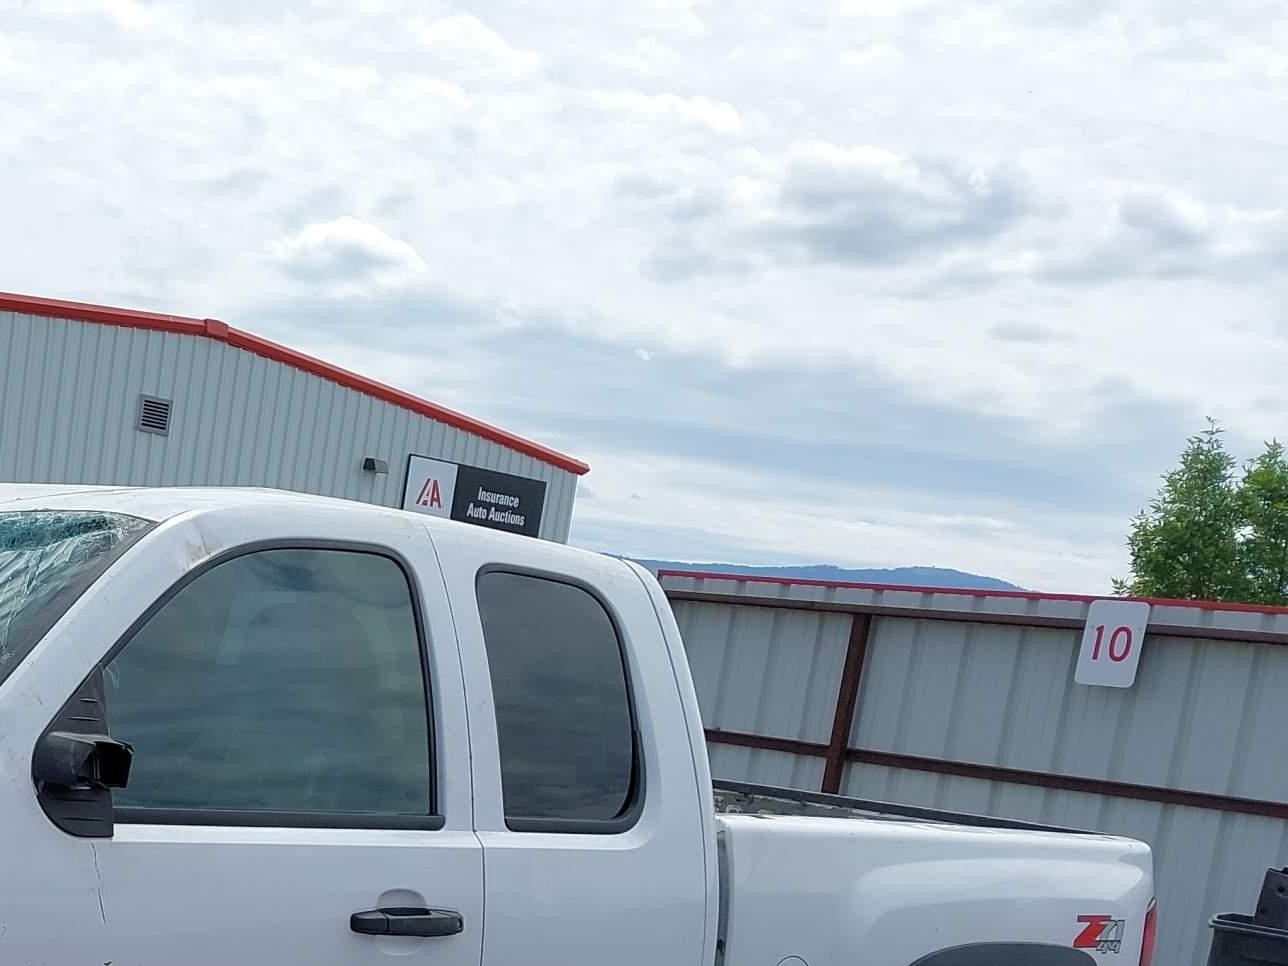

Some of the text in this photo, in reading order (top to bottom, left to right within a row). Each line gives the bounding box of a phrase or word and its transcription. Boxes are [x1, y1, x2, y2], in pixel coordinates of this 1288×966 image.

[478, 486, 520, 508] Insurance
[466, 502, 526, 527] Auto Auctions
[1091, 624, 1133, 662] 10
